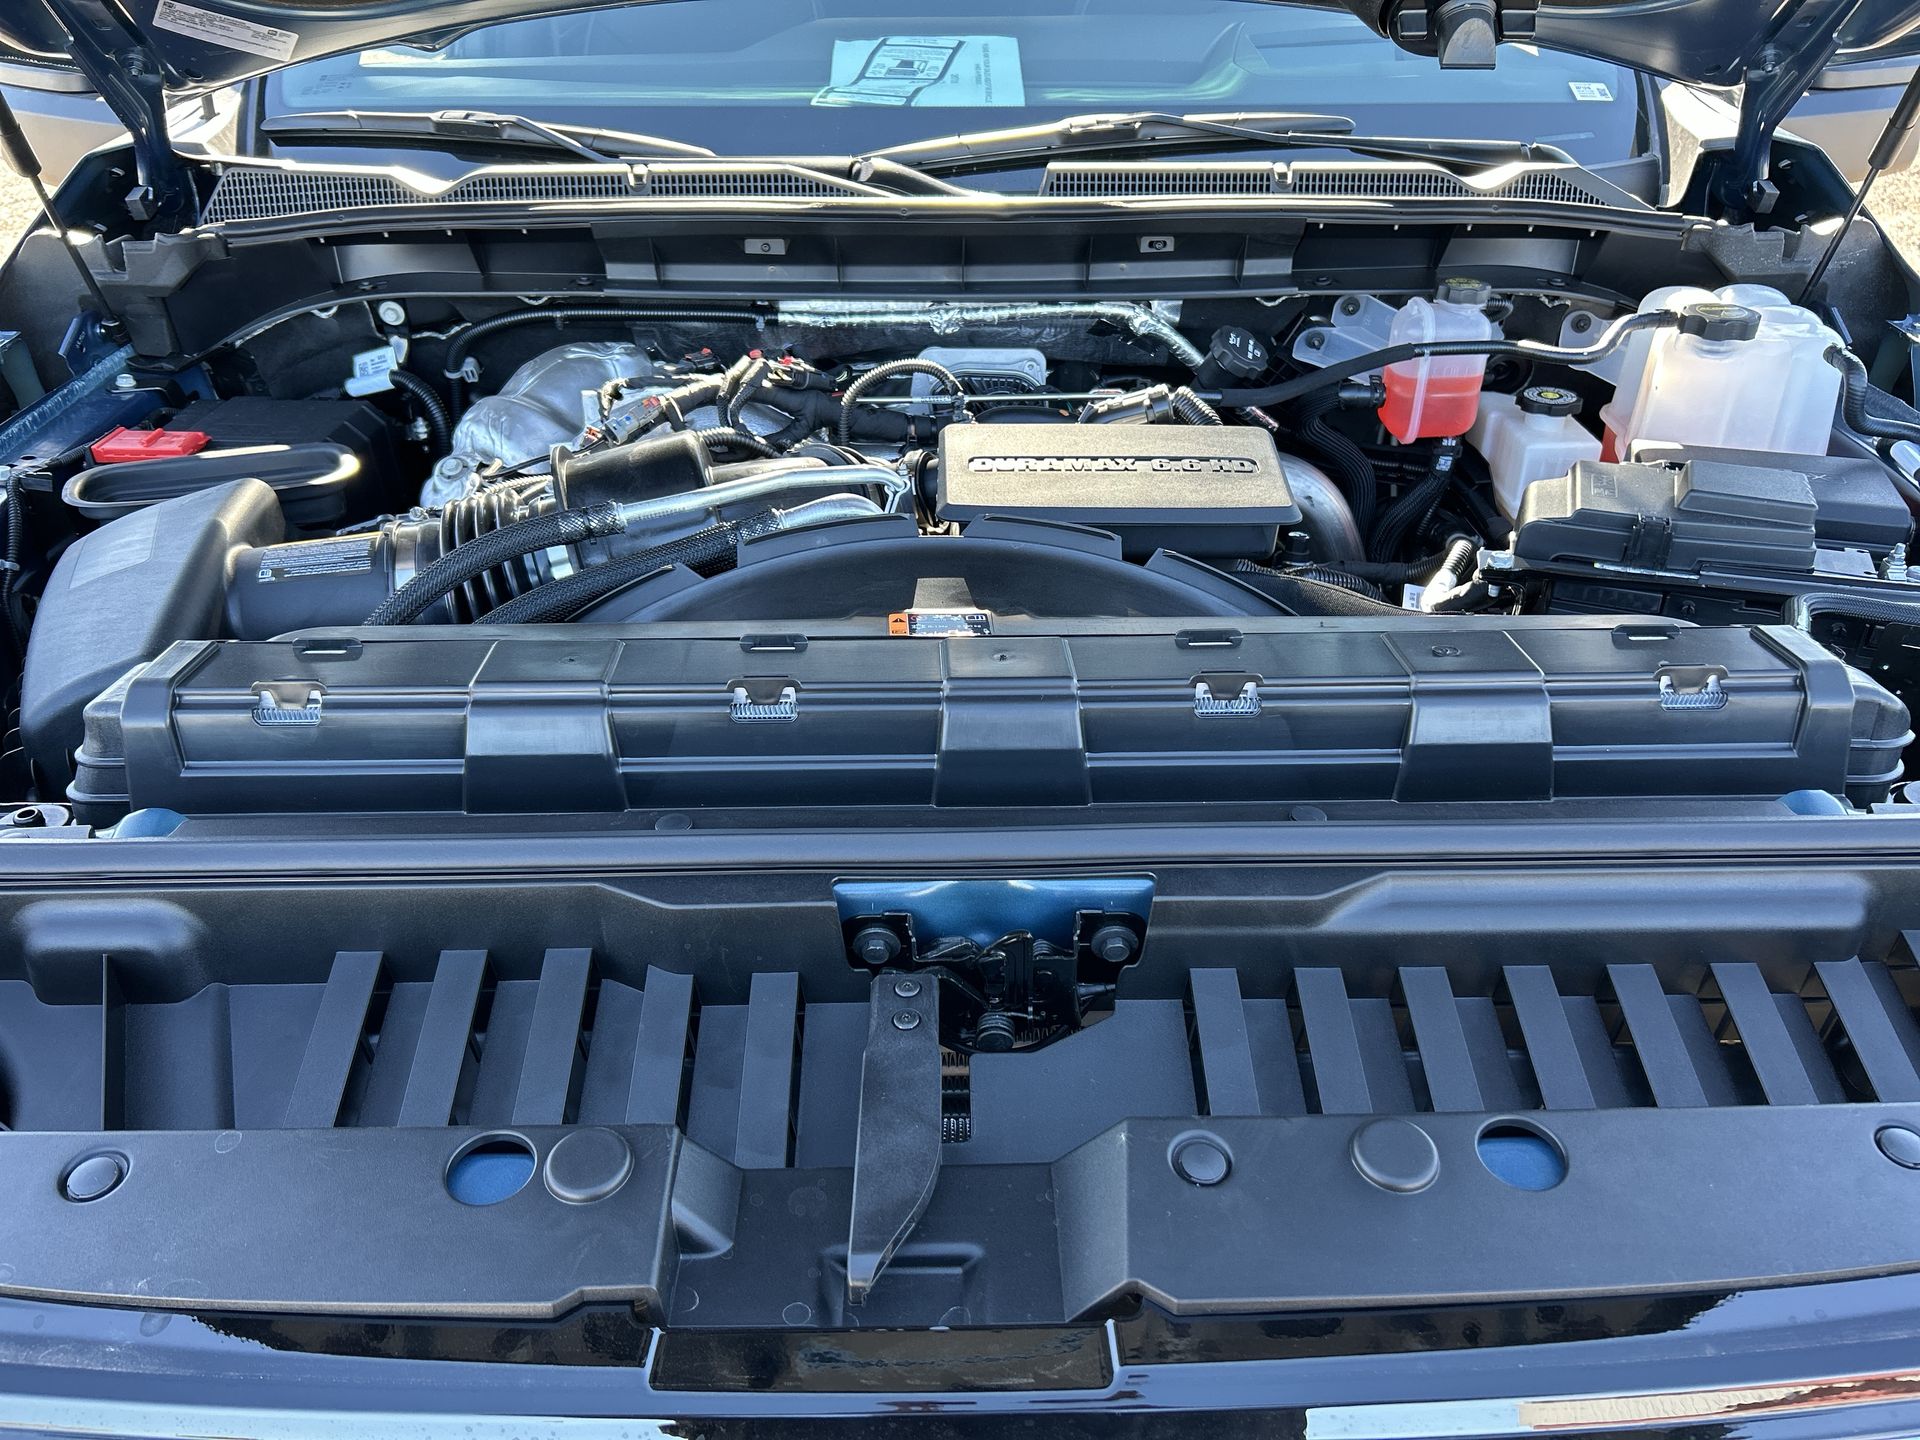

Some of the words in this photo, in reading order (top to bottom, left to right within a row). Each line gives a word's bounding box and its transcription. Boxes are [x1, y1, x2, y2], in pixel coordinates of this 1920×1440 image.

[969, 458, 1137, 472] DURAMAX
[1151, 459, 1202, 472] 6.6
[1210, 459, 1253, 473] HD
